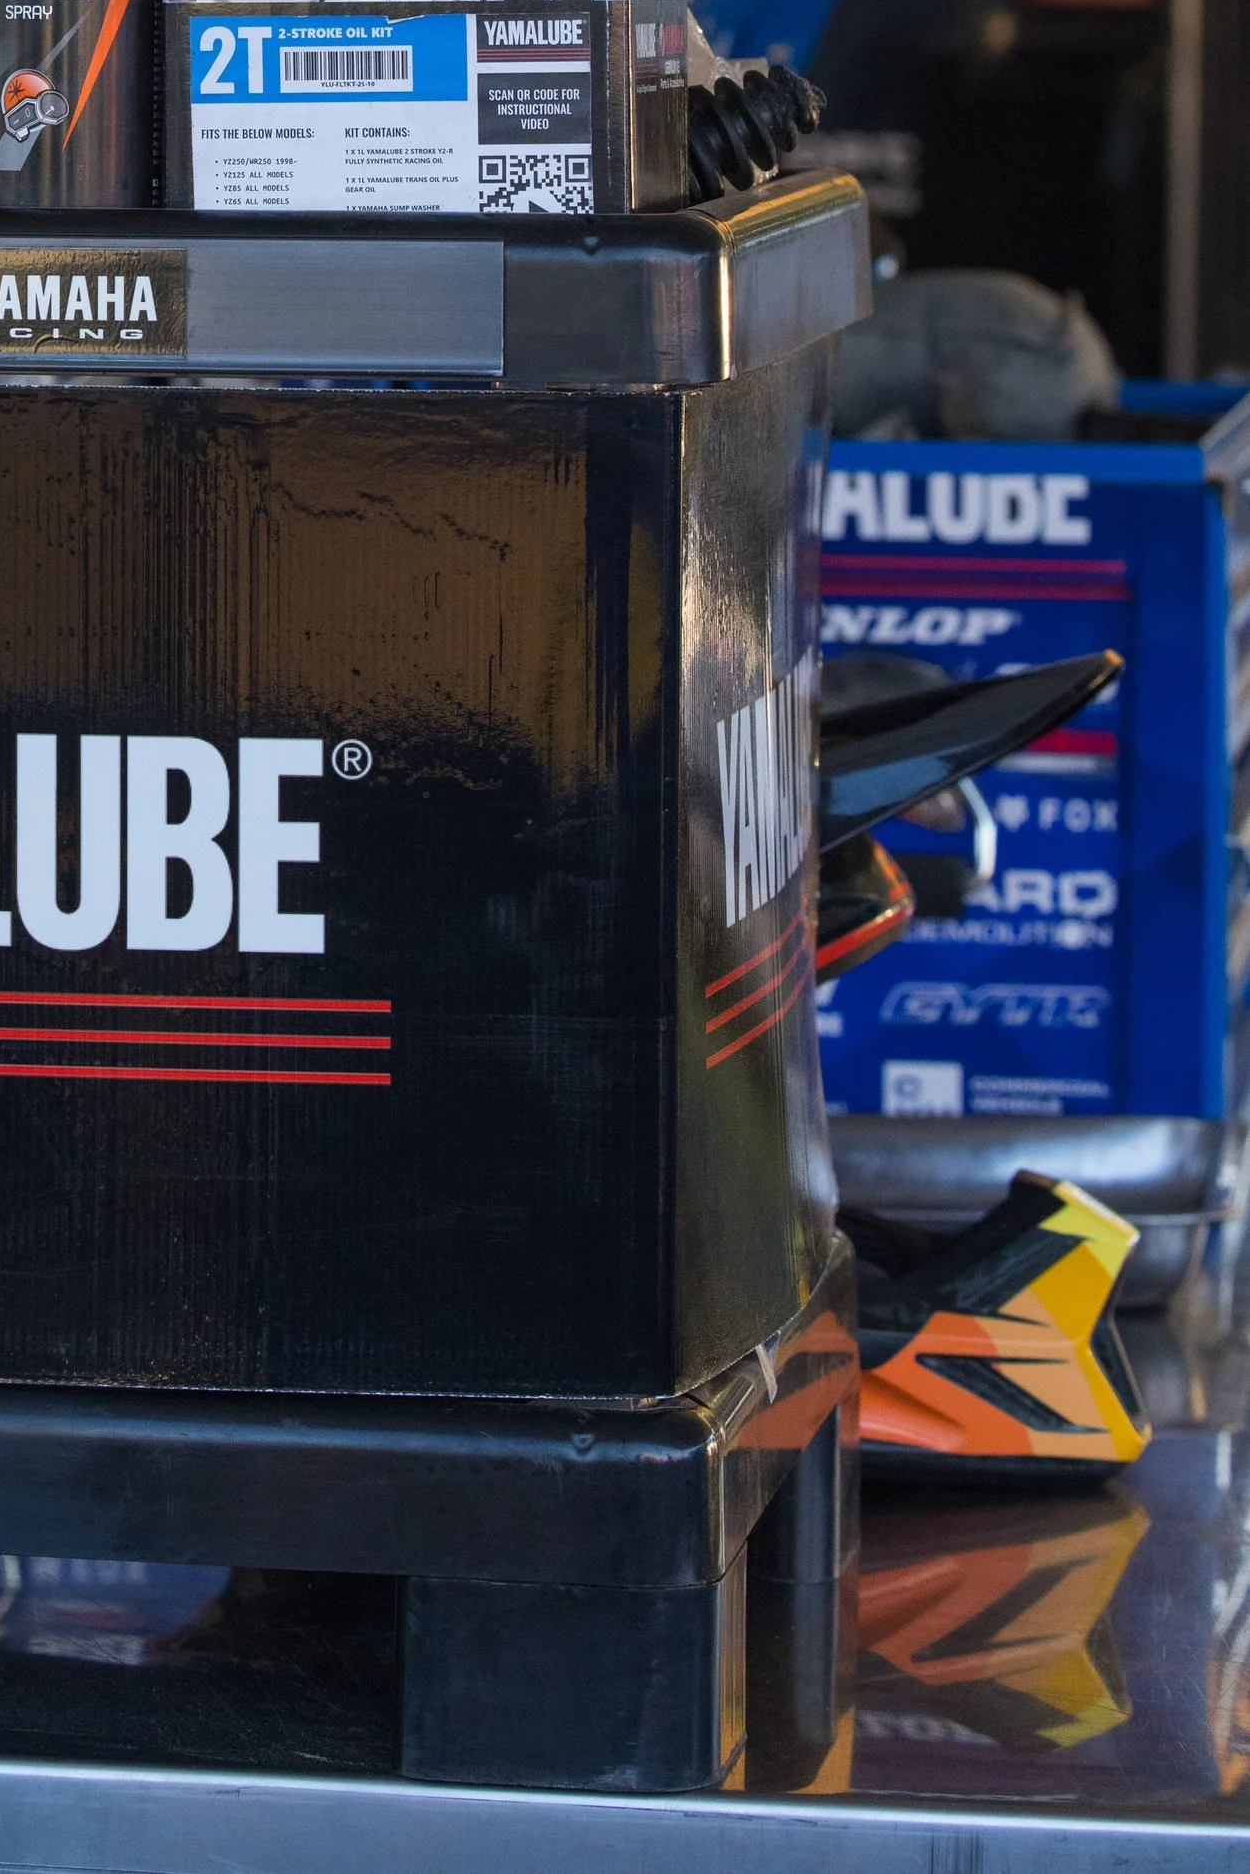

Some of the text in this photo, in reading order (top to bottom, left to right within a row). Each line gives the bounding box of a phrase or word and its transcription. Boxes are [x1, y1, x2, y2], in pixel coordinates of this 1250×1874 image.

[6, 5, 52, 19] SPRAY
[279, 27, 393, 39] 2-STROKE OIL KIT
[200, 26, 272, 94] 2T
[489, 89, 580, 101] SCAN QR CODE FOR
[498, 104, 571, 115] INSTRUCTIONAL
[521, 119, 549, 129] VIDEO
[201, 129, 314, 139] FITS THE BELOW MODELS:
[345, 127, 410, 138] KIT CONTAINS:
[223, 158, 271, 166] YZ250/WR250
[821, 471, 1092, 545] ALUBE
[821, 605, 1023, 646] NLOP
